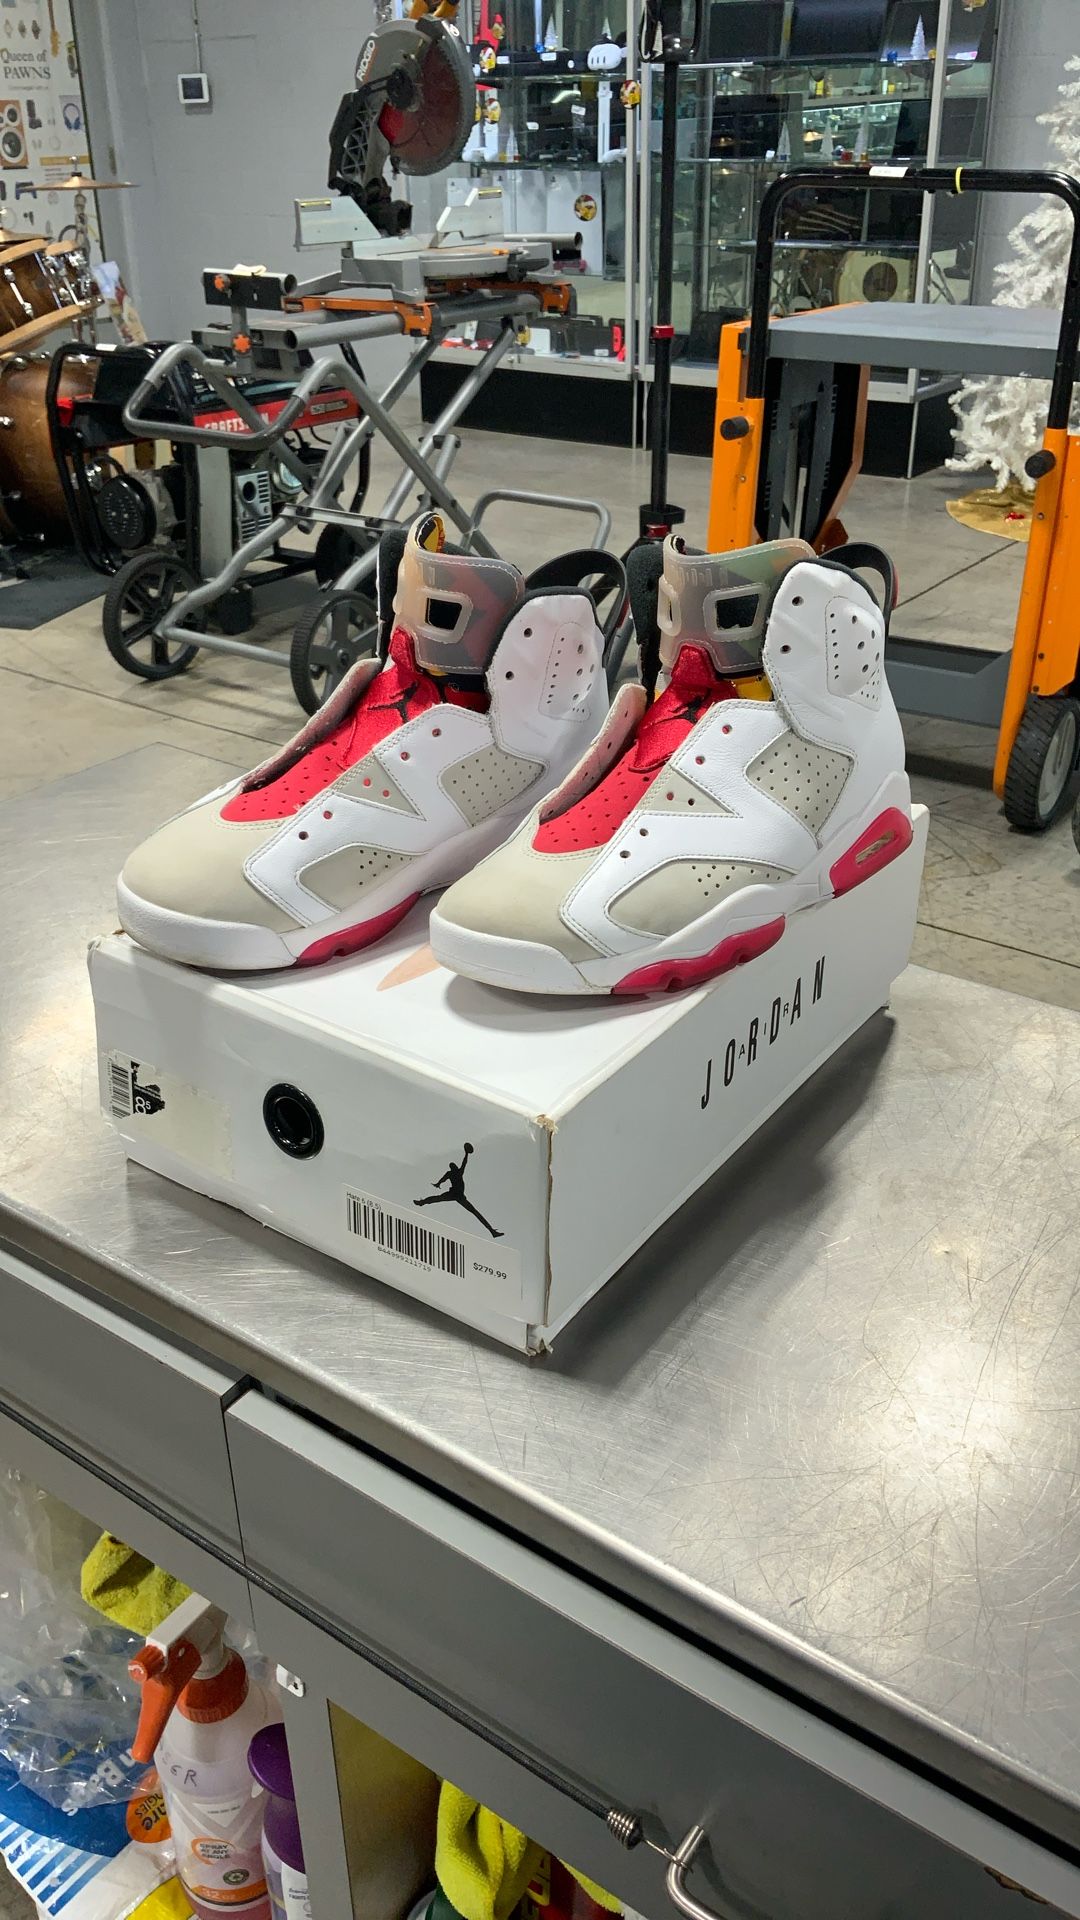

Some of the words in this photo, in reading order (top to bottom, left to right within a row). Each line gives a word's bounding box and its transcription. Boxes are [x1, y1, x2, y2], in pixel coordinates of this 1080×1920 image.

[0, 48, 35, 63] Queen
[37, 49, 47, 62] of
[4, 66, 51, 79] PAWNS
[701, 955, 826, 1110] JORDAN
[472, 1262, 507, 1280] $279.99
